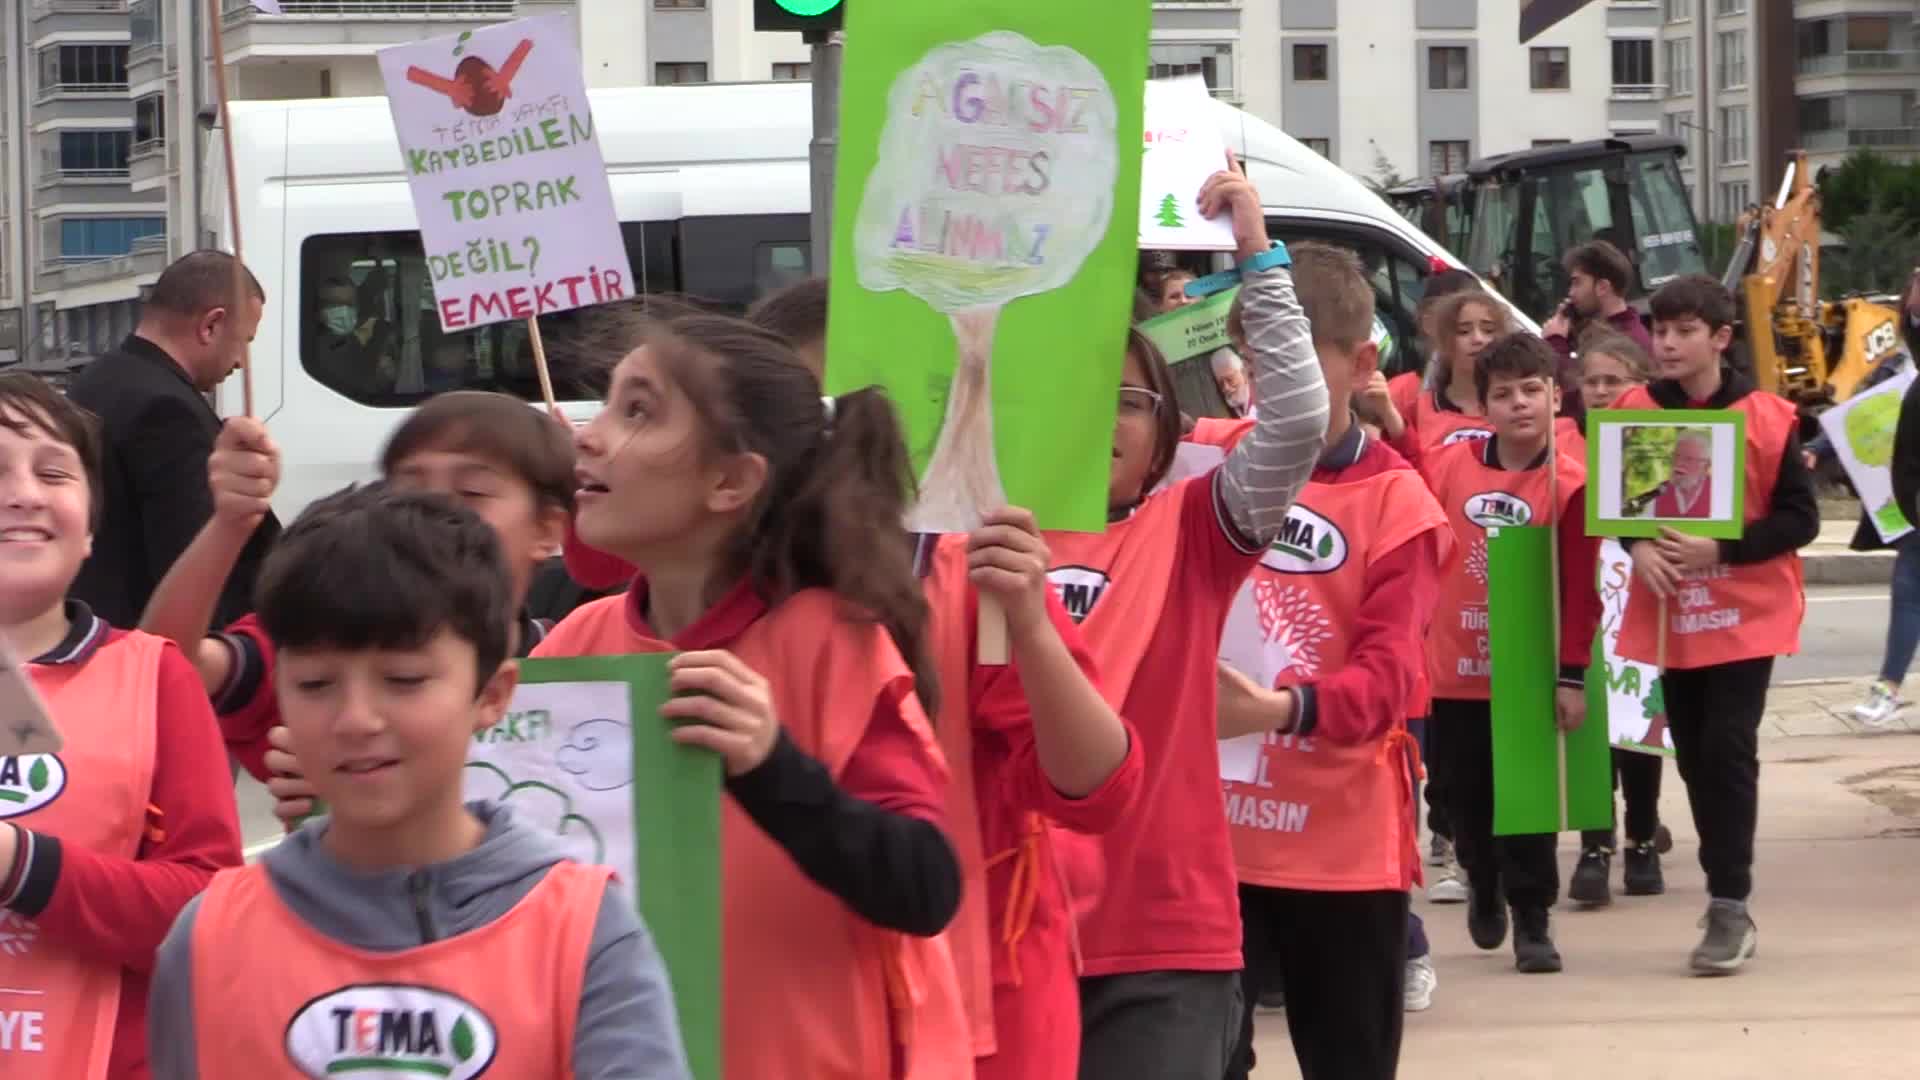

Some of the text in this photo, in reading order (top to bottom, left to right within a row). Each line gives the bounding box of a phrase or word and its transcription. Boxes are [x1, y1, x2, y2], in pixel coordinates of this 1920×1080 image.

[936, 144, 1051, 196] NEFES
[443, 175, 581, 222] TOPRAK
[429, 236, 541, 281] DEĞİL?
[440, 264, 626, 330] EMEKTİR
[1863, 320, 1896, 362] JCB
[1277, 516, 1316, 549] MA
[1224, 792, 1312, 833] MASIN
[0, 1011, 44, 1052] YE
[330, 1006, 441, 1058] TEMA
